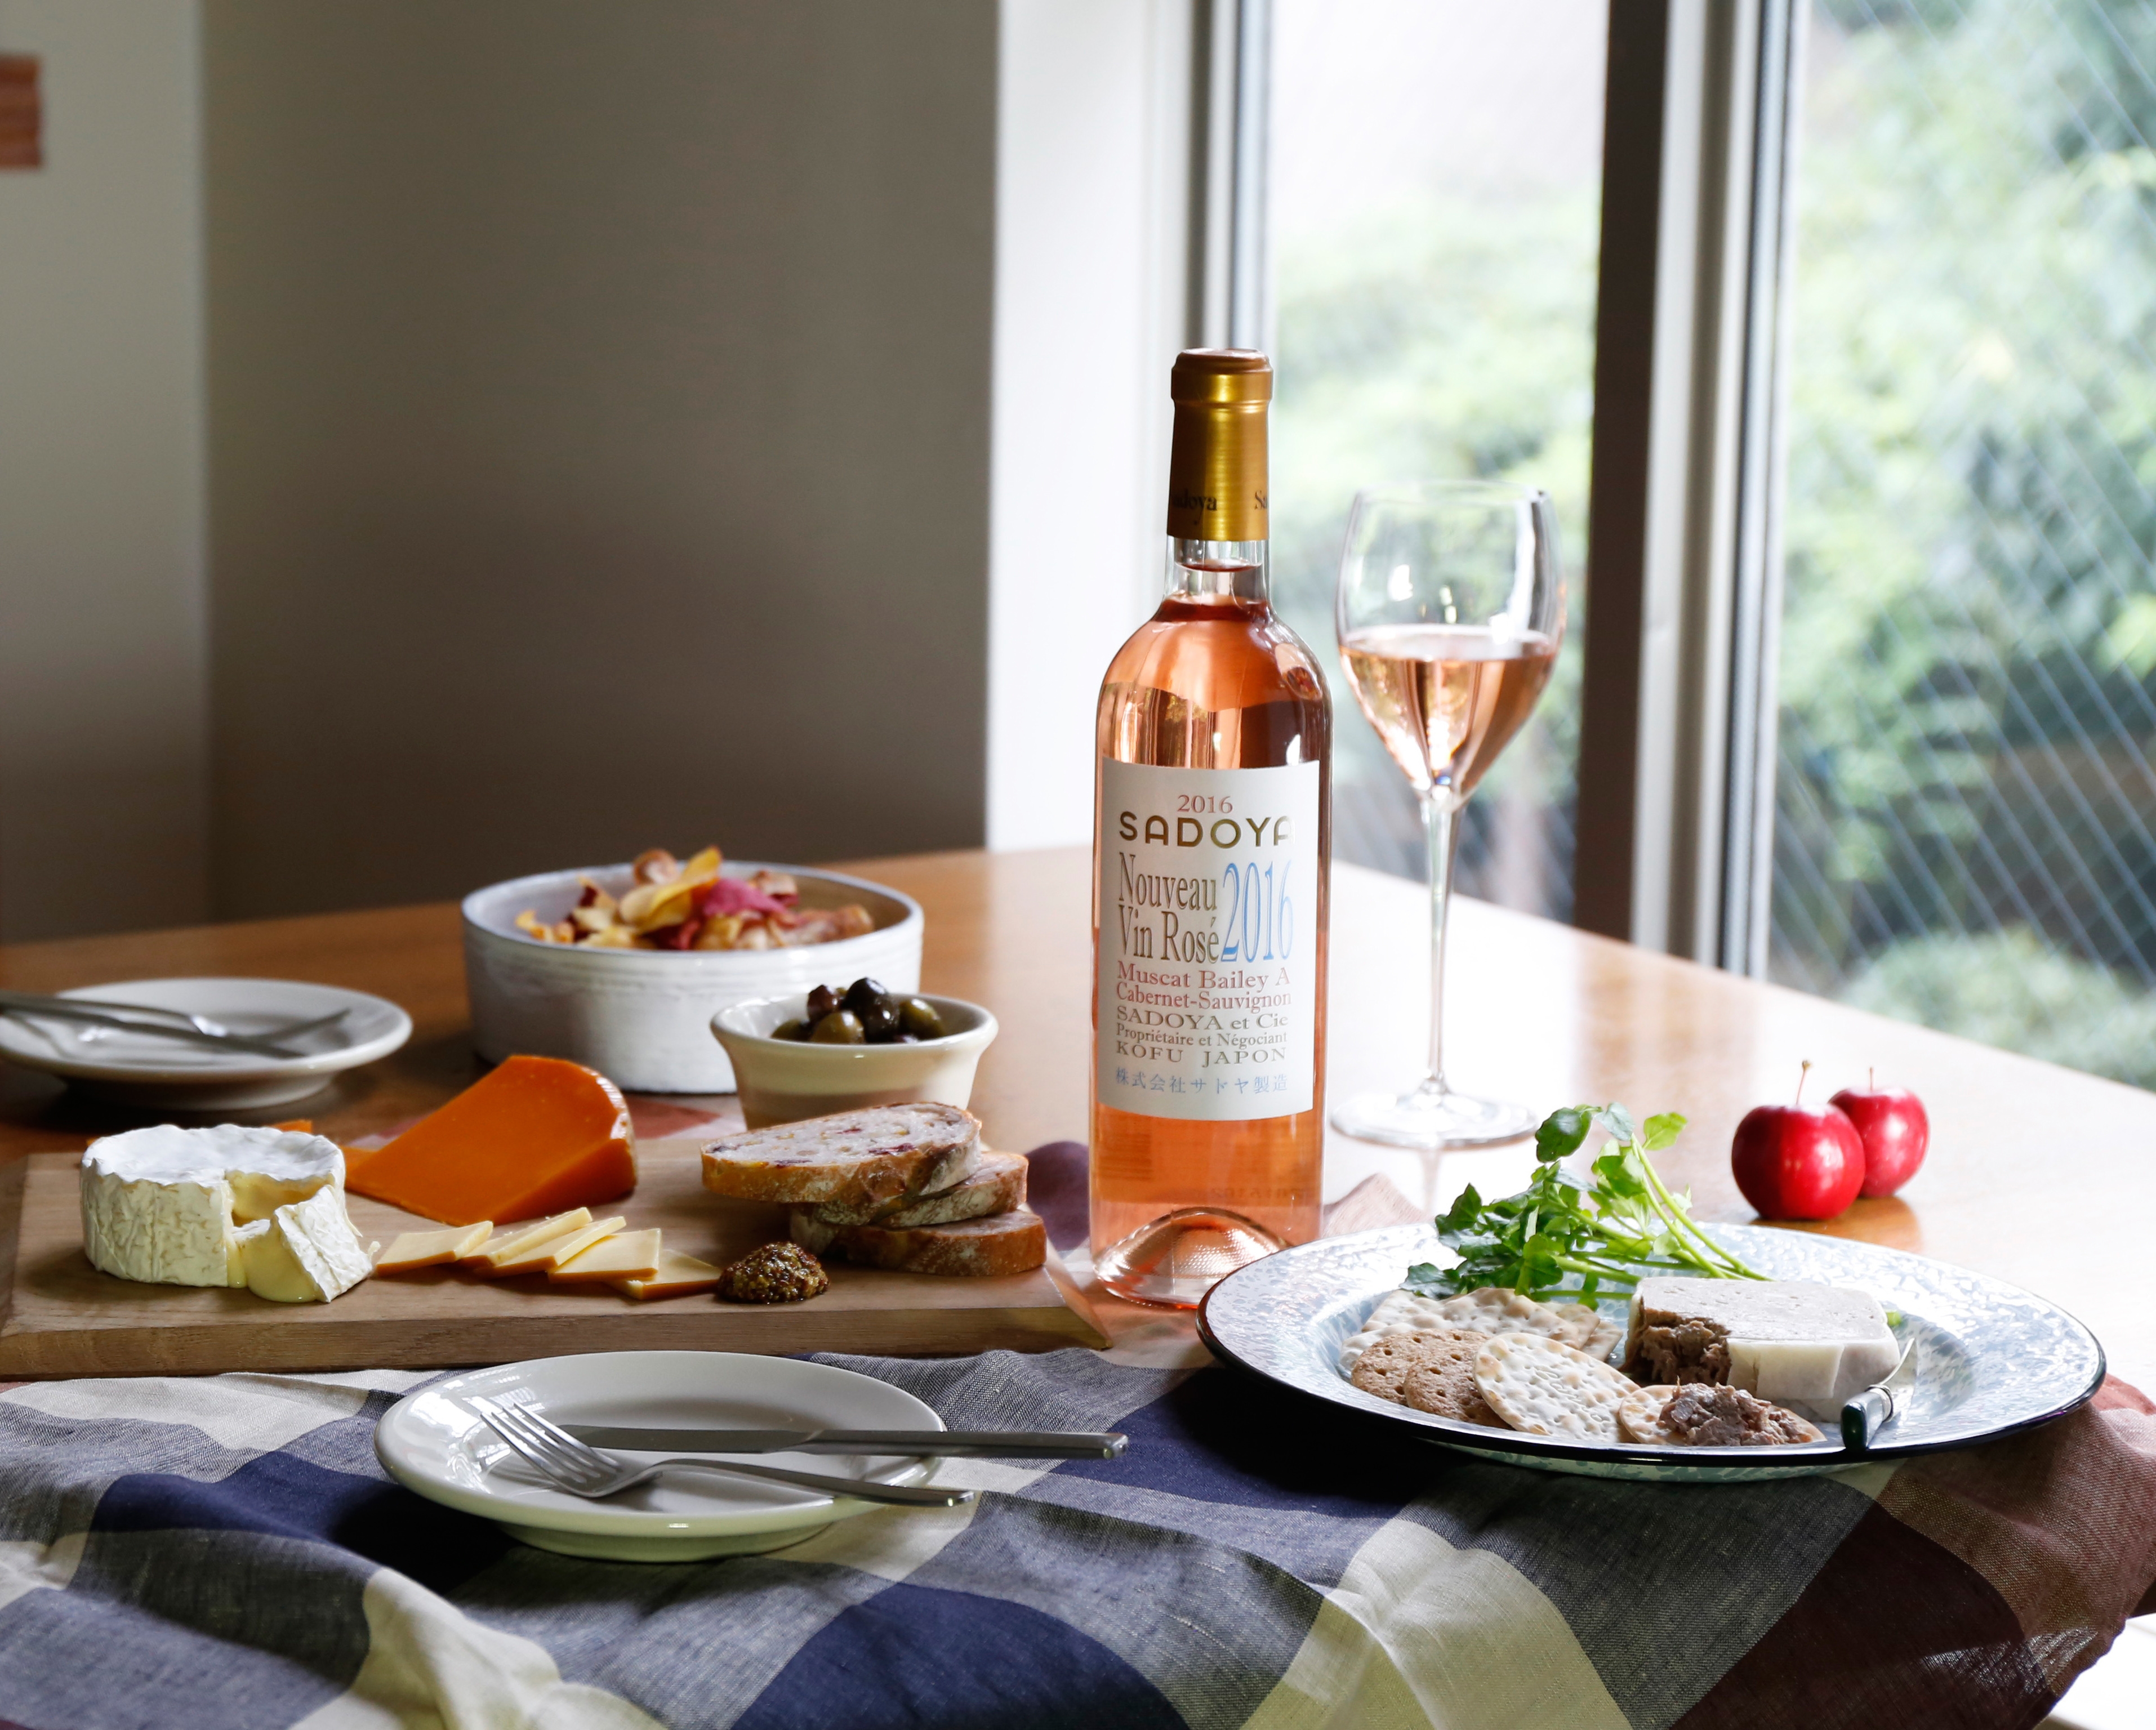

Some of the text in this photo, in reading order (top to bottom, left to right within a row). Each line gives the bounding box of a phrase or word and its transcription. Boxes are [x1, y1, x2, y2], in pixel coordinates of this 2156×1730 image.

[1177, 794, 1233, 814] 2016
[1119, 811, 1295, 849] SADOYA
[1119, 851, 1217, 911] Nouveau
[1220, 859, 1294, 963] 2016
[1118, 904, 1219, 964] Vin Rosé
[1117, 960, 1290, 993] Muscat Bailey A
[1116, 982, 1292, 1014] Cabernet-Sauvignon
[1116, 1005, 1289, 1030] SADOYA et Cie
[1116, 1022, 1288, 1050] Propriétaire et Négociant
[1116, 1041, 1286, 1068] KOFU JAPON
[1116, 1067, 1288, 1094] 株式会社サドヤ製造
